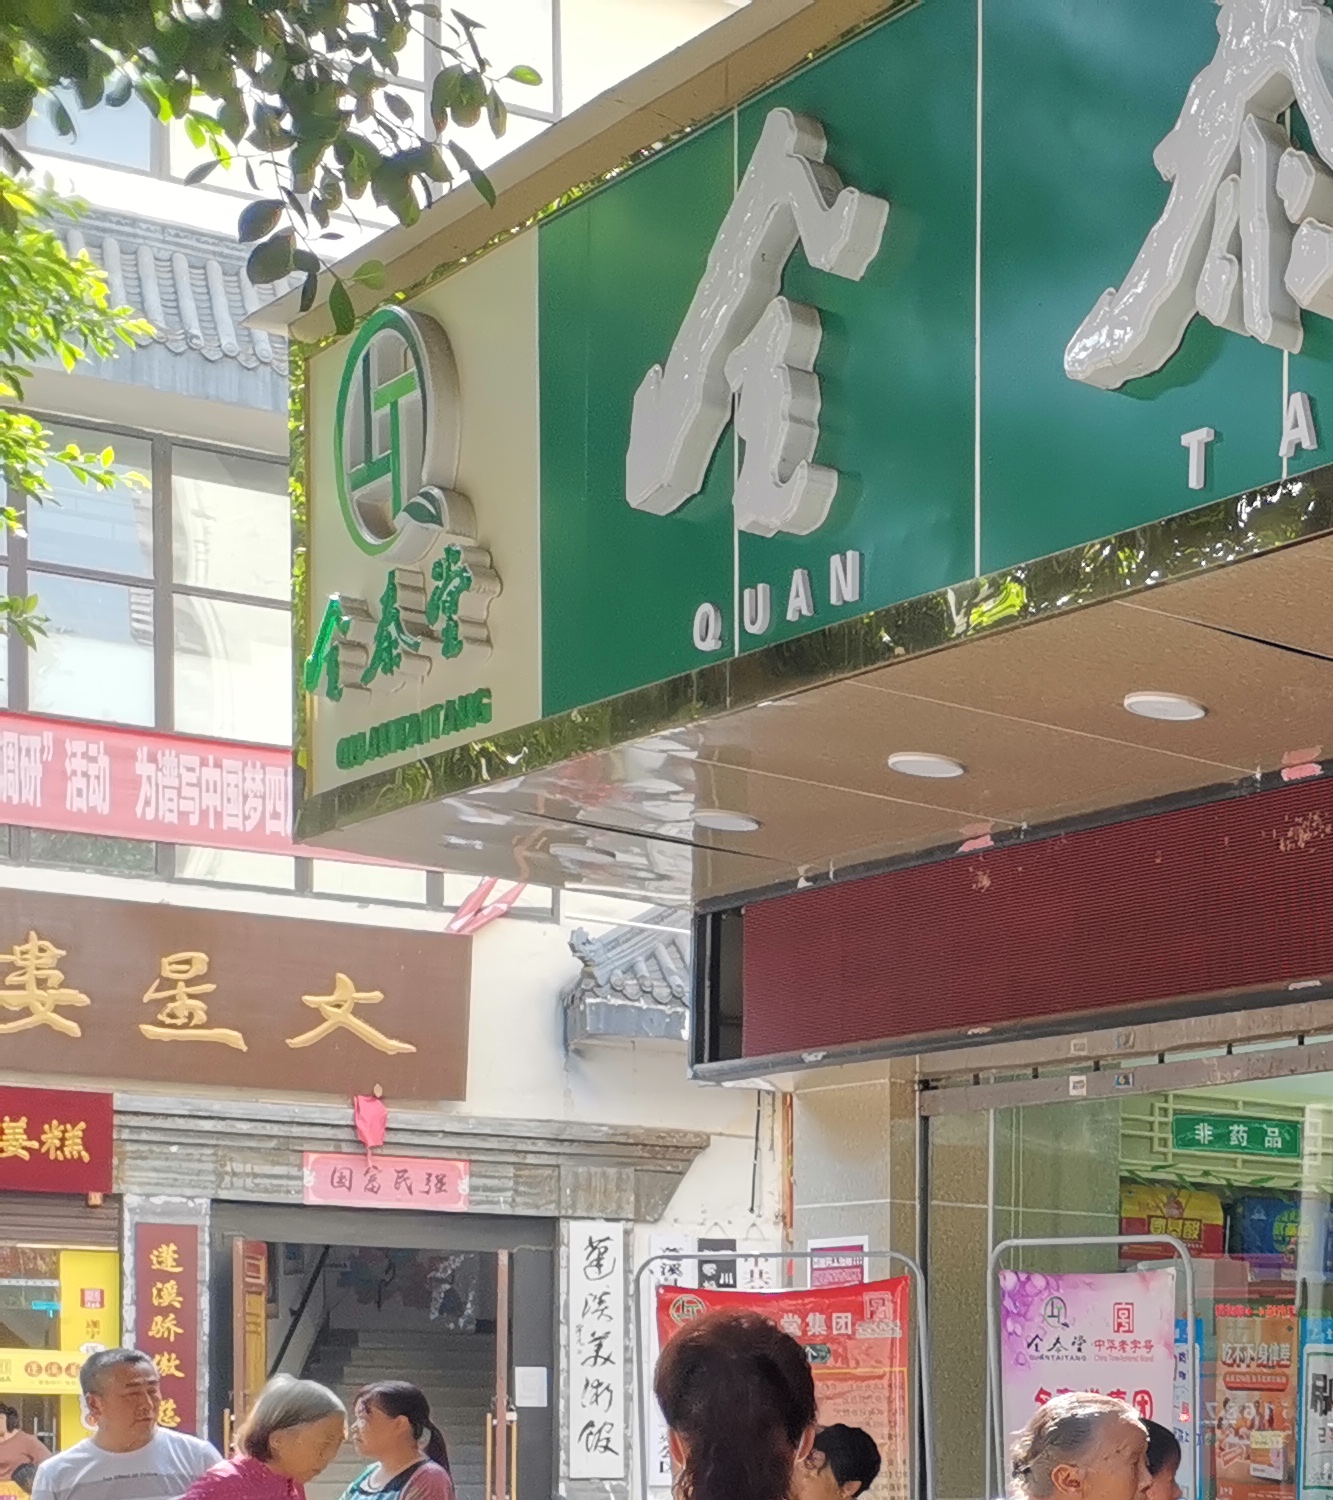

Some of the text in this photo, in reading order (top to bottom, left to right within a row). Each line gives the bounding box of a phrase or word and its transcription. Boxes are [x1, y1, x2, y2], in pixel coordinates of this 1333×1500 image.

[692, 550, 860, 652] QUAN
[1195, 1123, 1282, 1149] 非药品
[329, 1166, 449, 1196] 国富民强
